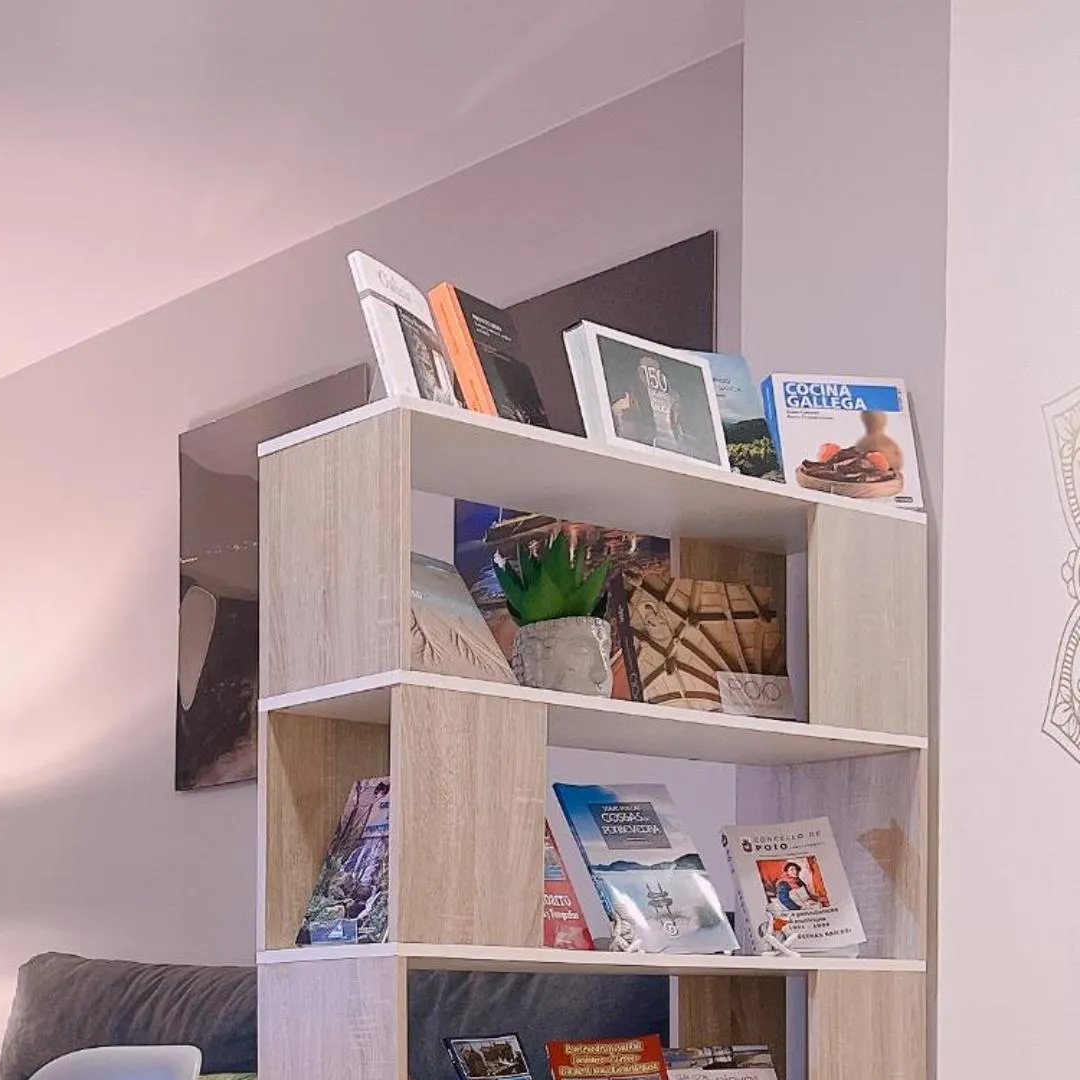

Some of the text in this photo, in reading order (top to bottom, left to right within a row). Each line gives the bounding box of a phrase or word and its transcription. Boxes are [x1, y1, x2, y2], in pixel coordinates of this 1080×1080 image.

[785, 382, 852, 397] COCINA
[787, 395, 868, 411] GALLEGA
[755, 843, 788, 851] POIO
